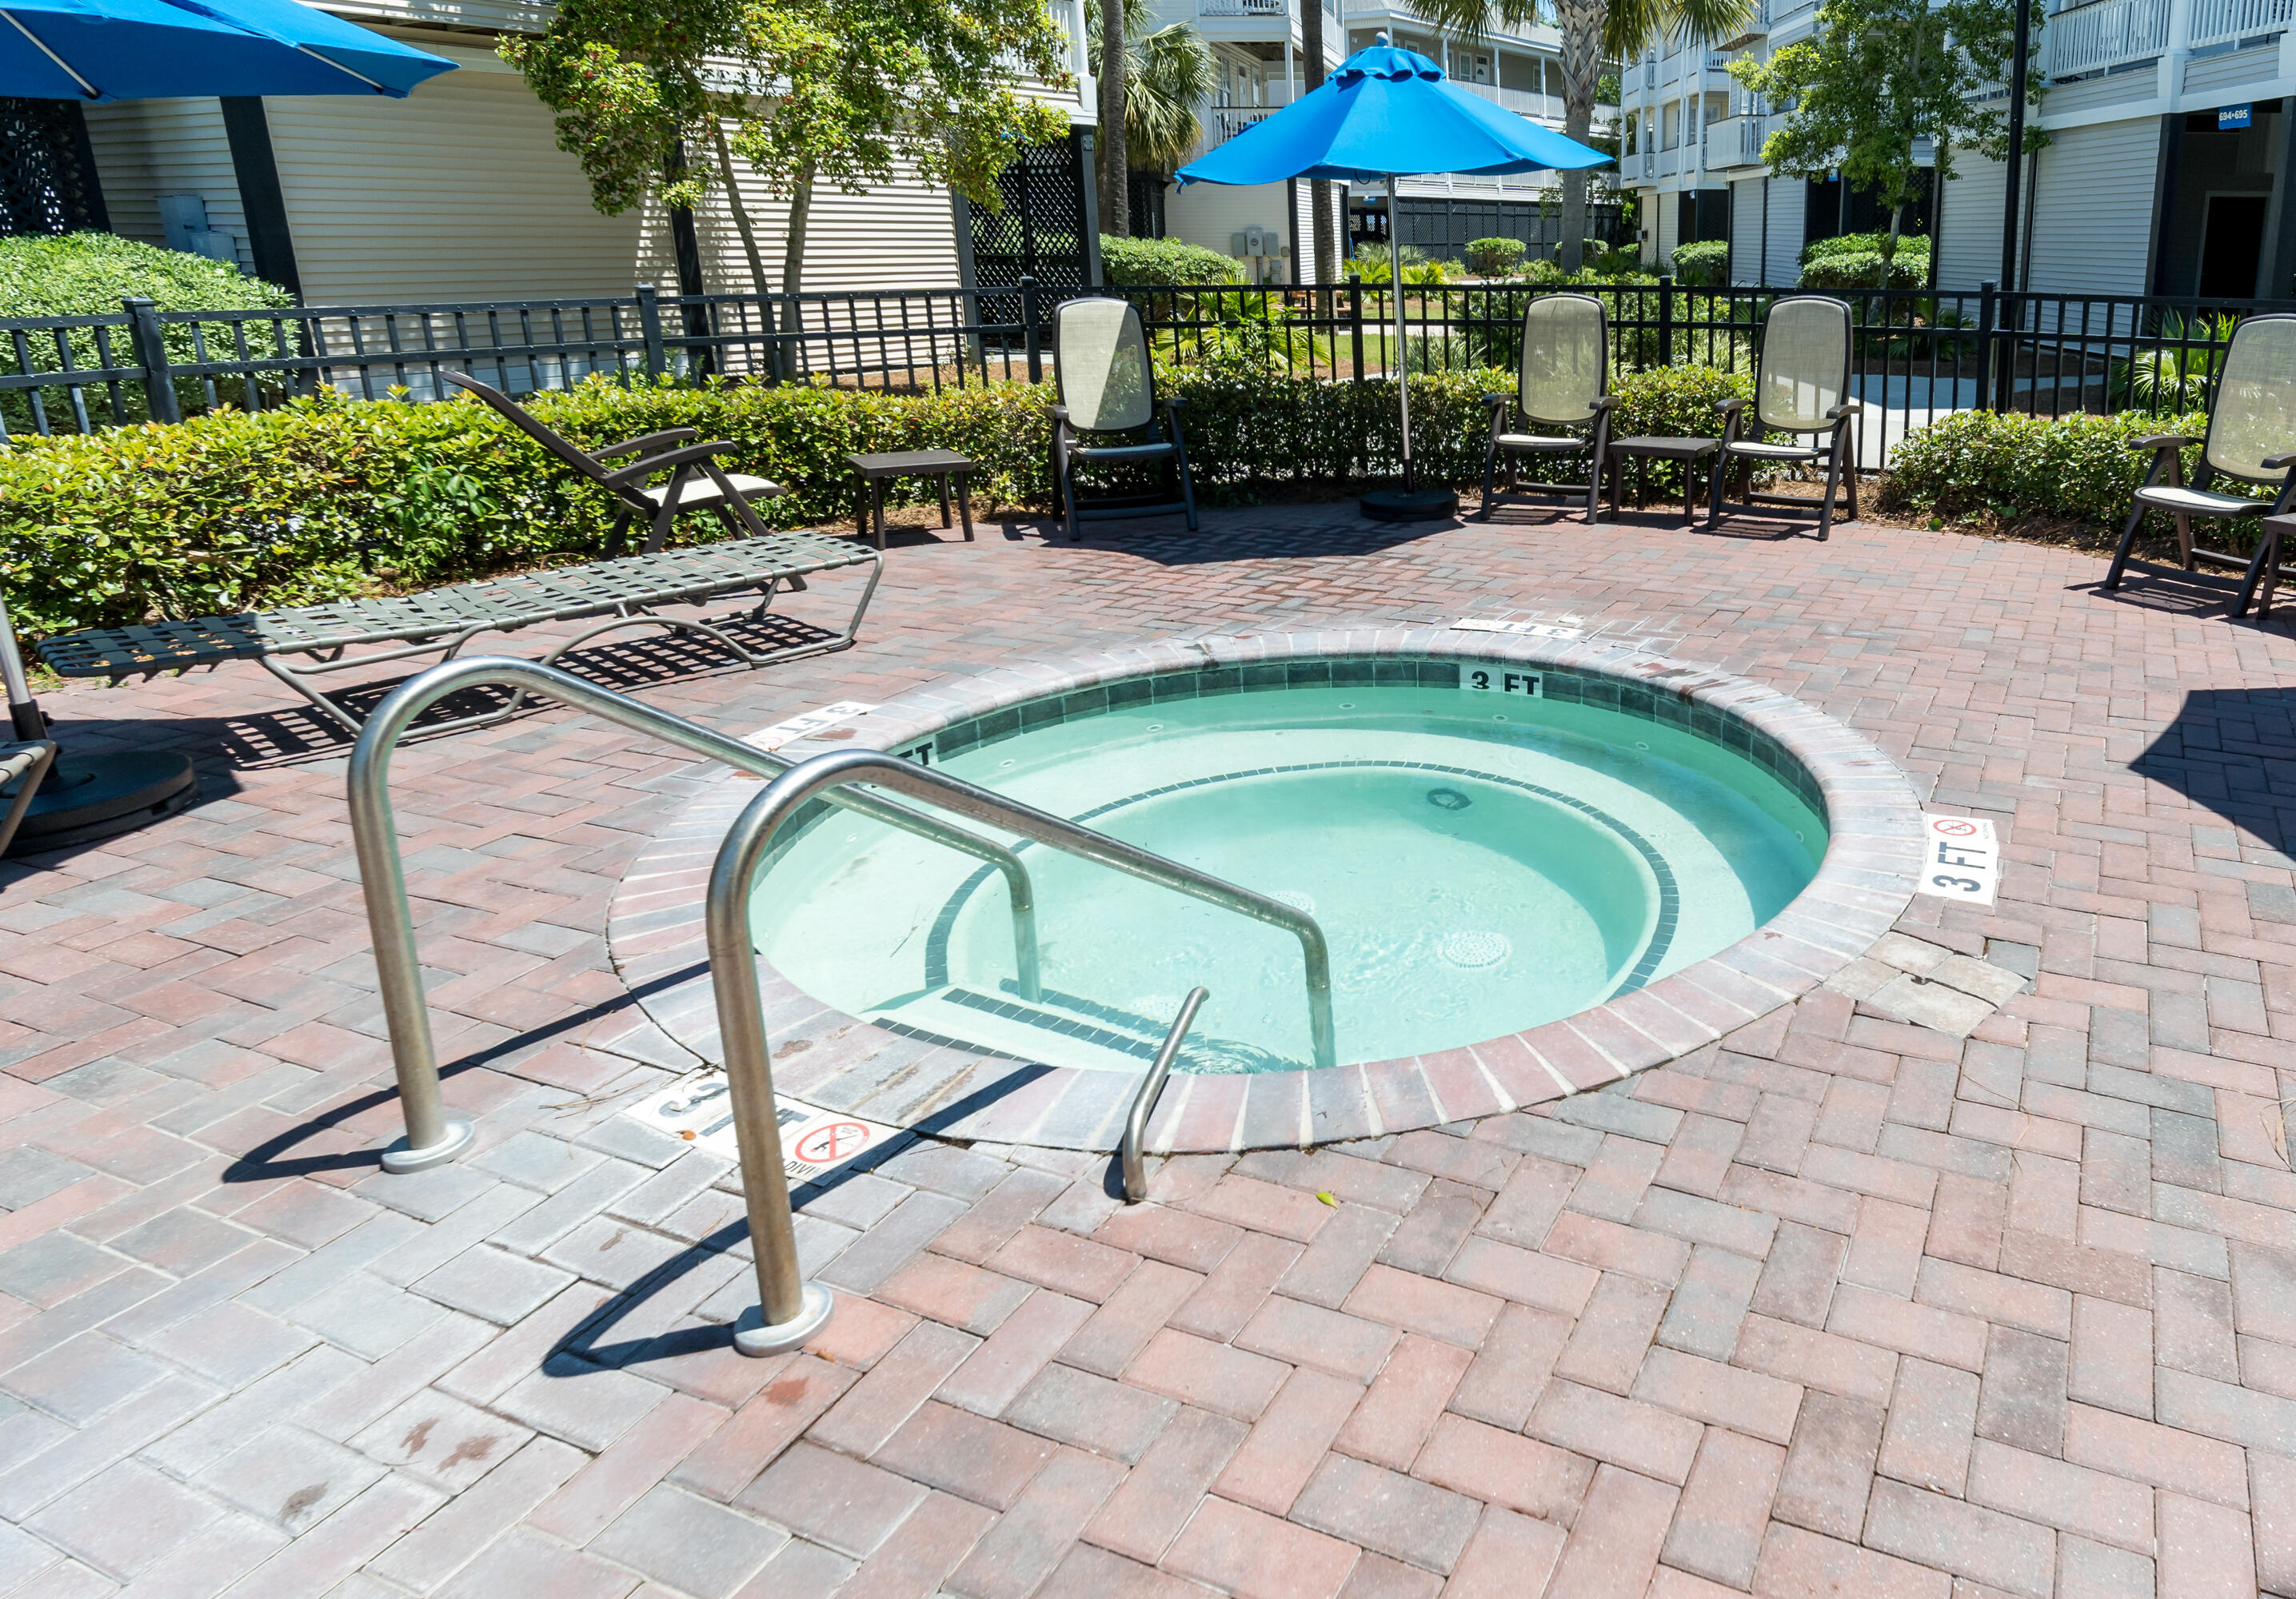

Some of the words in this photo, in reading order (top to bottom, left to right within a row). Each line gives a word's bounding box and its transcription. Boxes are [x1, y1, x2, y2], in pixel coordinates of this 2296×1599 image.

[1496, 624, 1537, 632] FT
[1471, 671, 1490, 690] 3
[1504, 673, 1539, 695] FT
[825, 706, 861, 715] 3
[776, 718, 829, 734] FT
[897, 742, 933, 766] T
[1938, 841, 1987, 869] FT
[1932, 875, 1981, 892] 3
[658, 1083, 729, 1118] 3
